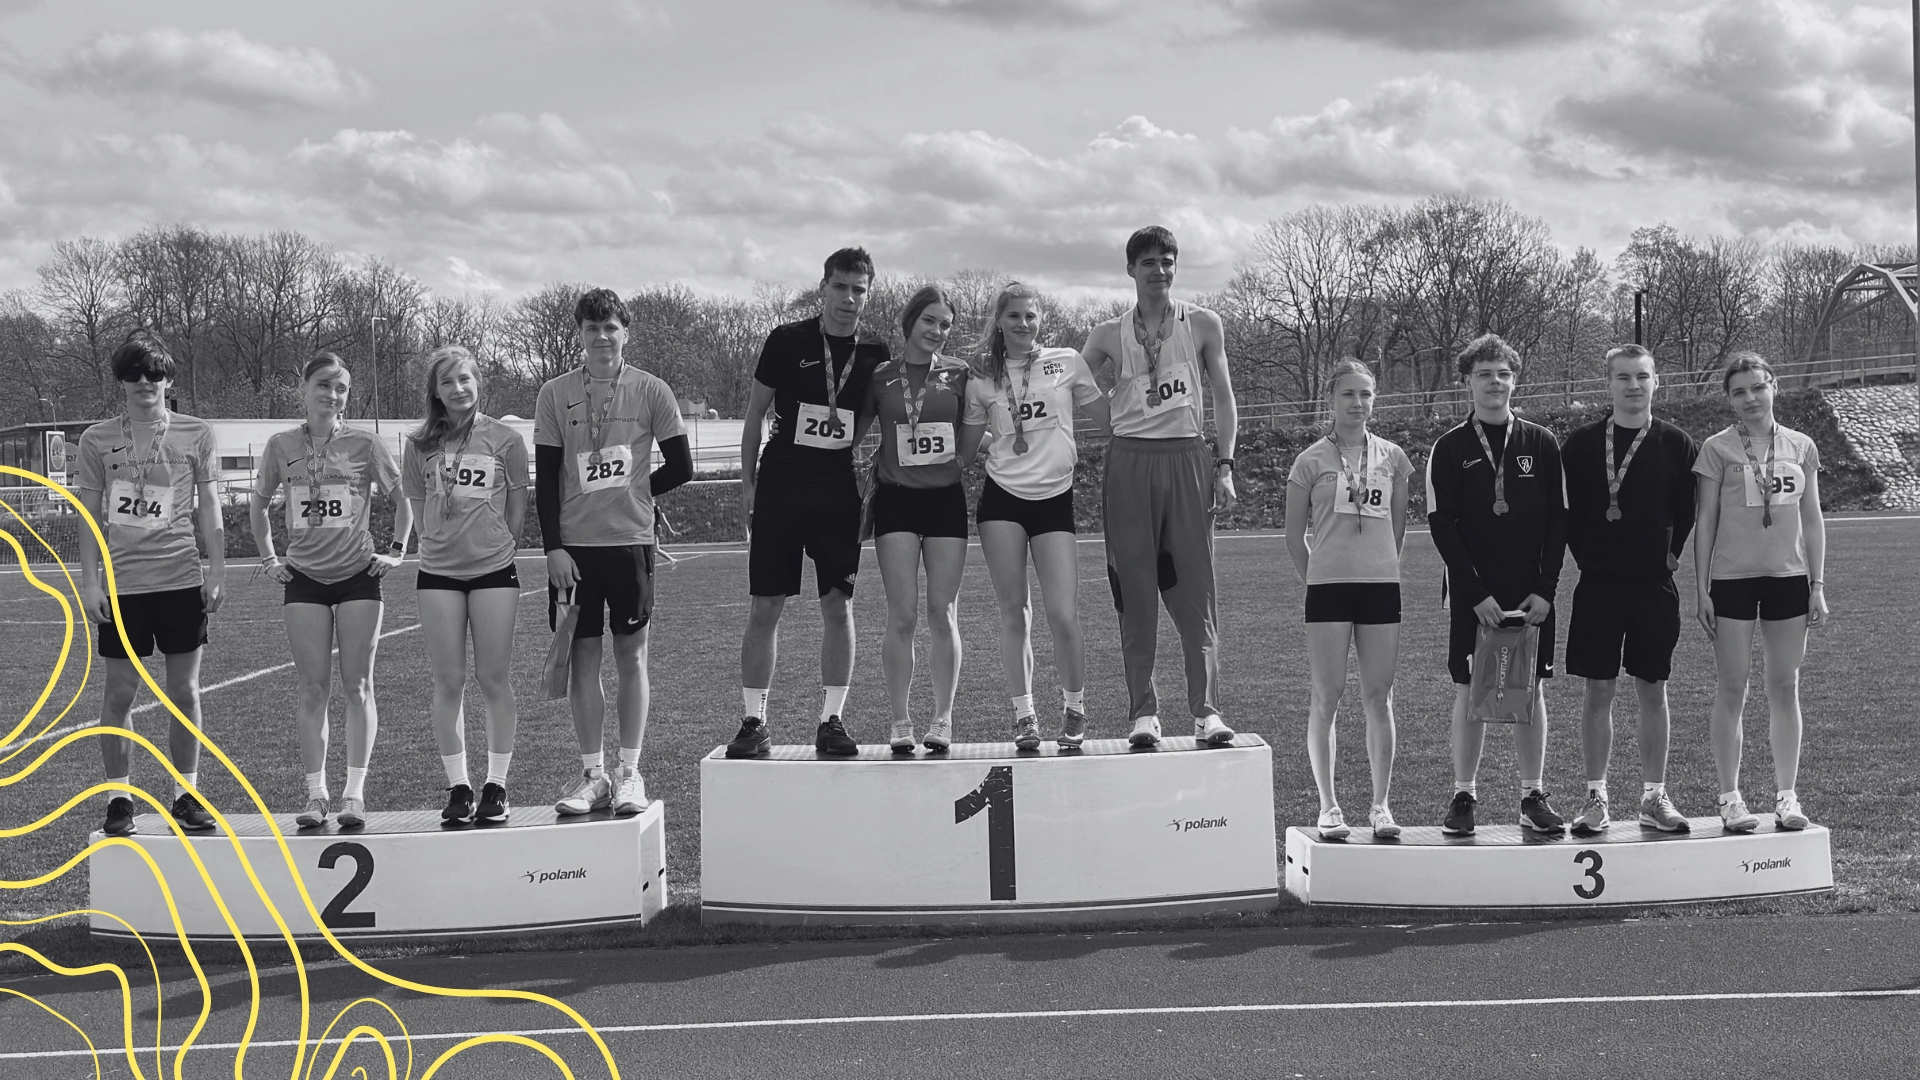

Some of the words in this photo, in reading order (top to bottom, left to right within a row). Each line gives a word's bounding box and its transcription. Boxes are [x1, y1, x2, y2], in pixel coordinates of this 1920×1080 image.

[1146, 379, 1187, 400] 04
[1008, 401, 1047, 420] 92
[804, 417, 846, 440] 205
[907, 436, 945, 455] 193
[446, 468, 486, 487] 92
[586, 459, 625, 482] 282
[1757, 476, 1796, 494] 95
[954, 766, 1017, 901] 1
[1184, 816, 1228, 832] polanik
[1572, 849, 1606, 899] 3
[1753, 856, 1792, 873] polanik
[318, 841, 376, 928] 2
[539, 867, 587, 884] polanik
